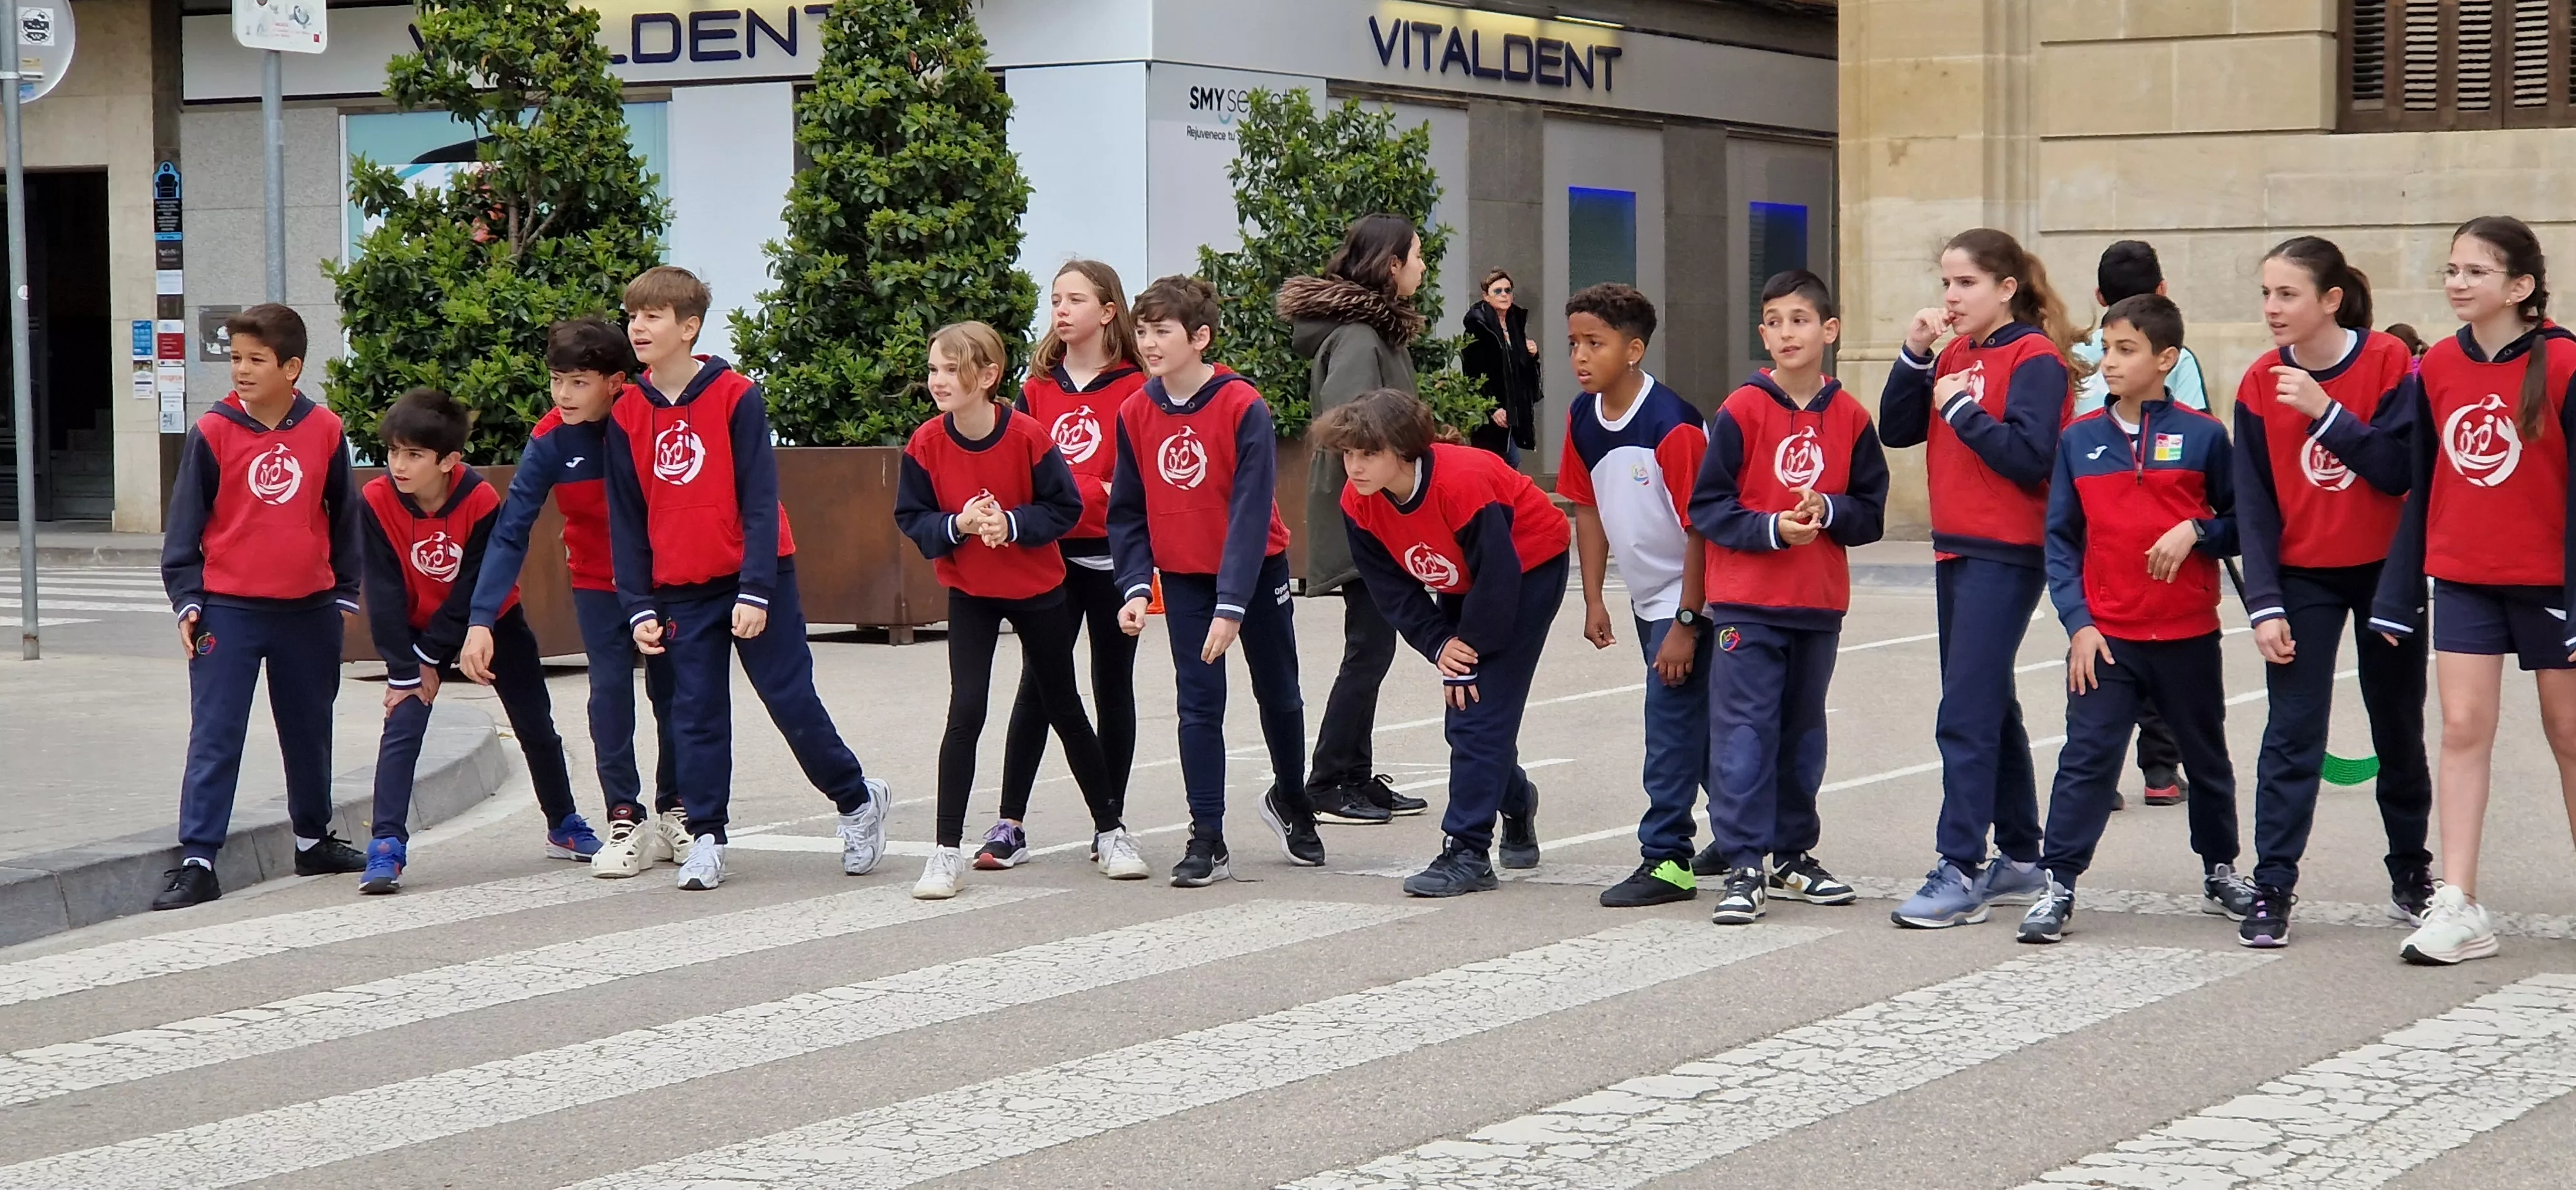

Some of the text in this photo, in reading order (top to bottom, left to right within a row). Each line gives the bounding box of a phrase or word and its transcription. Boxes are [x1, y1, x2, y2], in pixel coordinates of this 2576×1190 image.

[1368, 15, 1623, 91] VITALDENT
[1186, 125, 1236, 141] Rejuvenece tu
